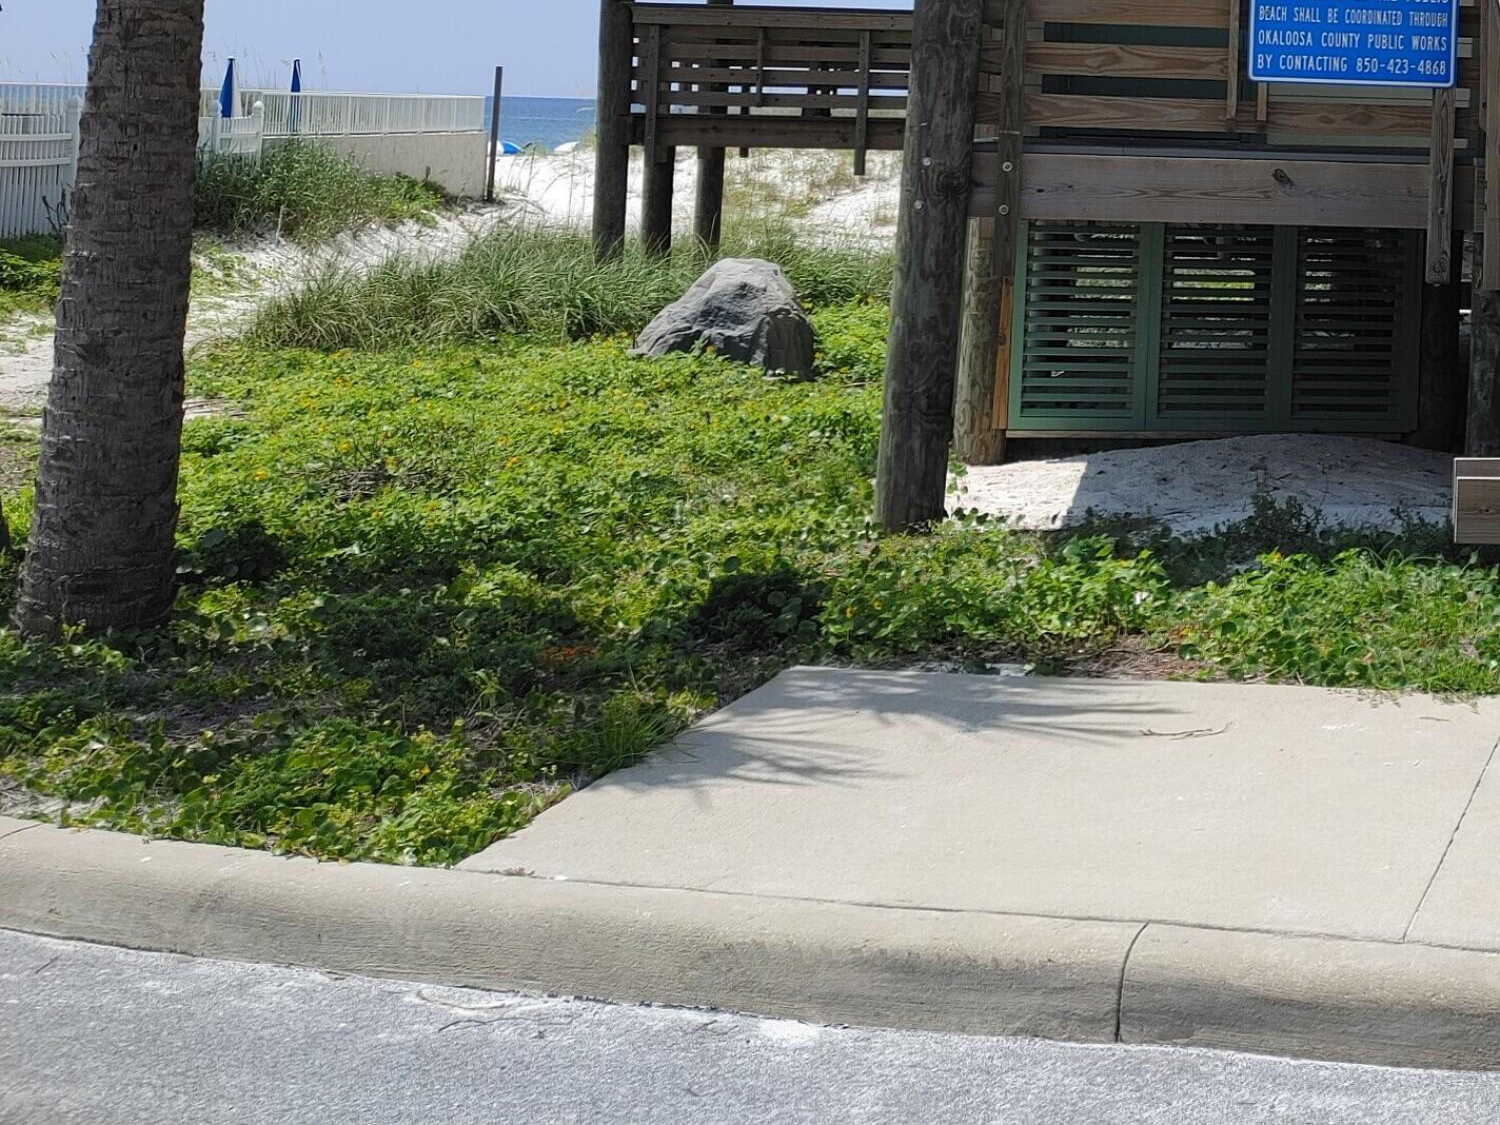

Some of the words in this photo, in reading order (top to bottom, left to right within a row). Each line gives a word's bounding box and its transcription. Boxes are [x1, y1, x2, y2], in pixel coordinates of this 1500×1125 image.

[1259, 6, 1287, 21] BEACH
[1294, 7, 1320, 23] SHALL
[1328, 9, 1338, 23] BE
[1345, 9, 1402, 26] COORDINATED
[1409, 12, 1448, 27] THROUGH
[1259, 30, 1312, 46] OKALOOSA
[1321, 32, 1360, 48] COUNTY
[1368, 34, 1404, 50] PUBLIC
[1412, 36, 1447, 51] WORKS
[1258, 55, 1272, 69] BY
[1280, 55, 1347, 72] CONTACTING
[1356, 58, 1446, 75] 850-423-4868
